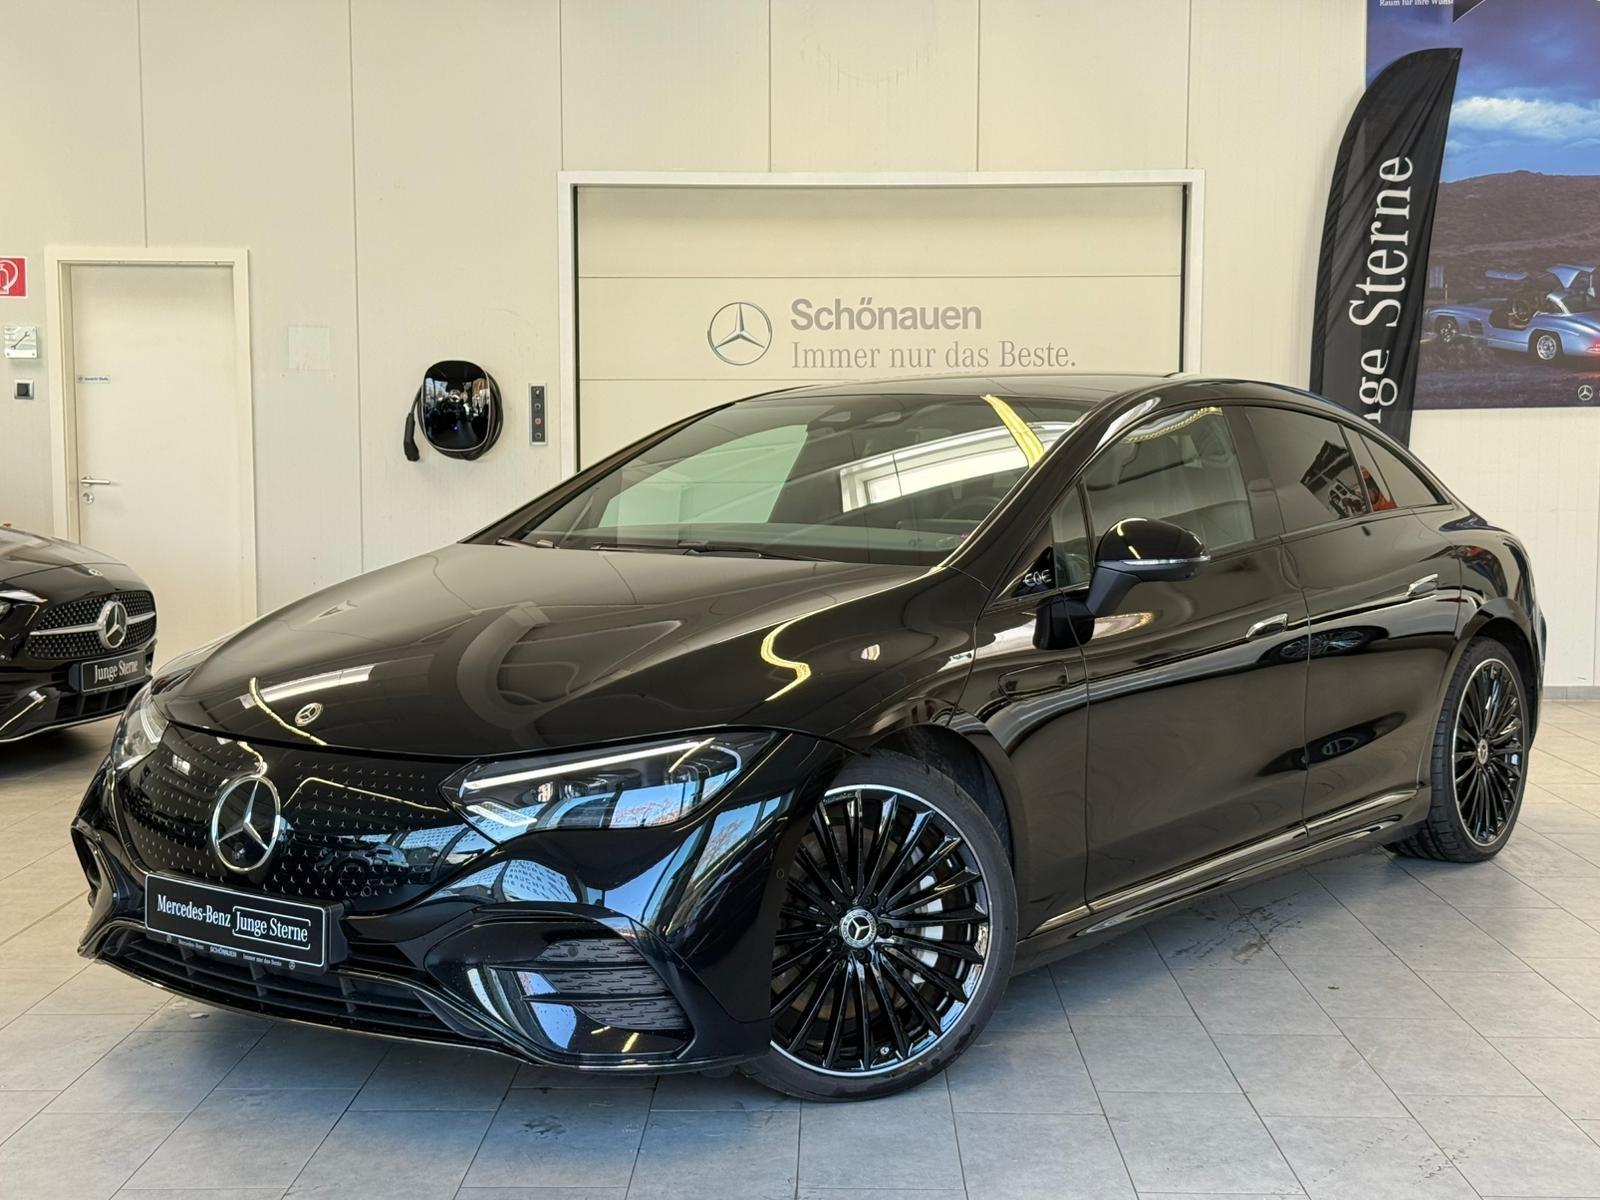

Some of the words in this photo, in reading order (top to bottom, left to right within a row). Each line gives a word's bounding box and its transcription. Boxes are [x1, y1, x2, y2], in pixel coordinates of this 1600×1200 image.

[1349, 156, 1413, 328] Sterne
[790, 297, 982, 331] Schönauen
[791, 341, 881, 368] Immer
[888, 348, 937, 368] nur
[945, 341, 989, 368] das
[999, 340, 1077, 368] Beste.
[1023, 569, 1052, 587] EQE
[94, 664, 118, 684] Junge
[118, 660, 139, 676] Sterne
[157, 894, 231, 927] Mercedes-Benz
[235, 911, 268, 937] Junge
[269, 917, 308, 942] Sterne
